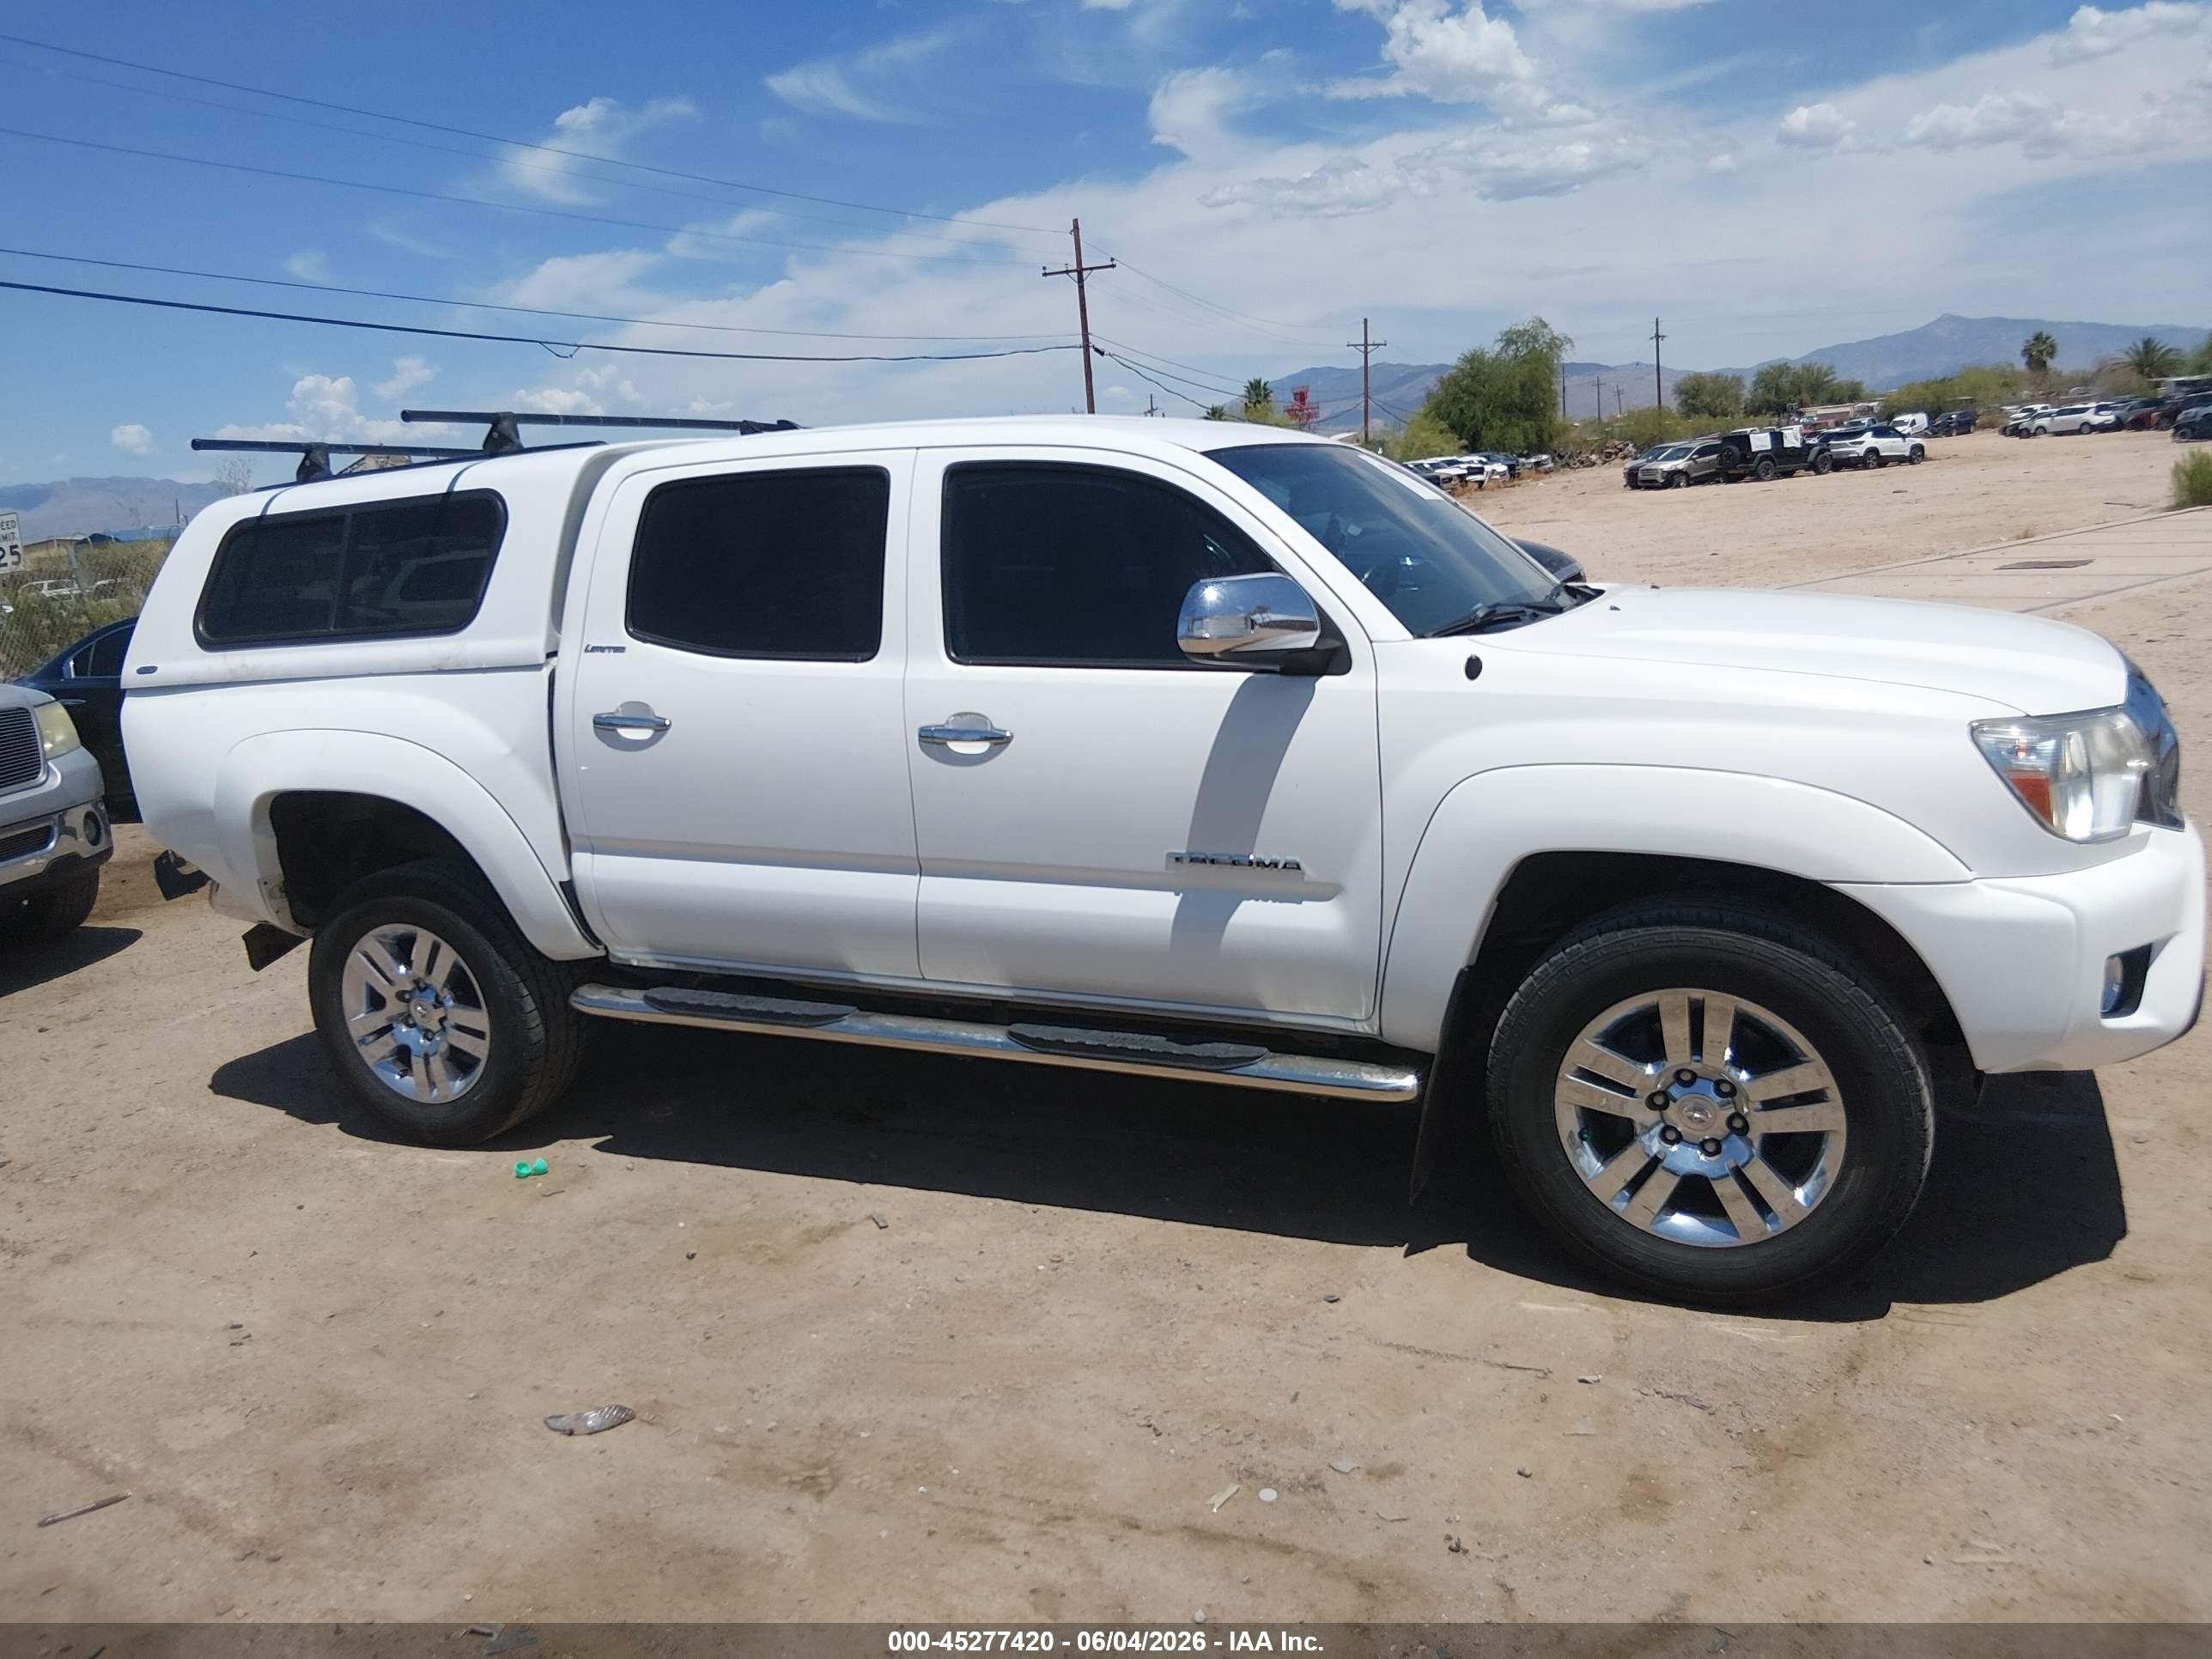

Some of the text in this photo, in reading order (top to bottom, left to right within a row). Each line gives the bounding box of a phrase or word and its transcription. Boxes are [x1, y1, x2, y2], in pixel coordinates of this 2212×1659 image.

[0, 520, 16, 531] EED
[0, 544, 21, 568] 25
[1165, 851, 1303, 872] TACOMA
